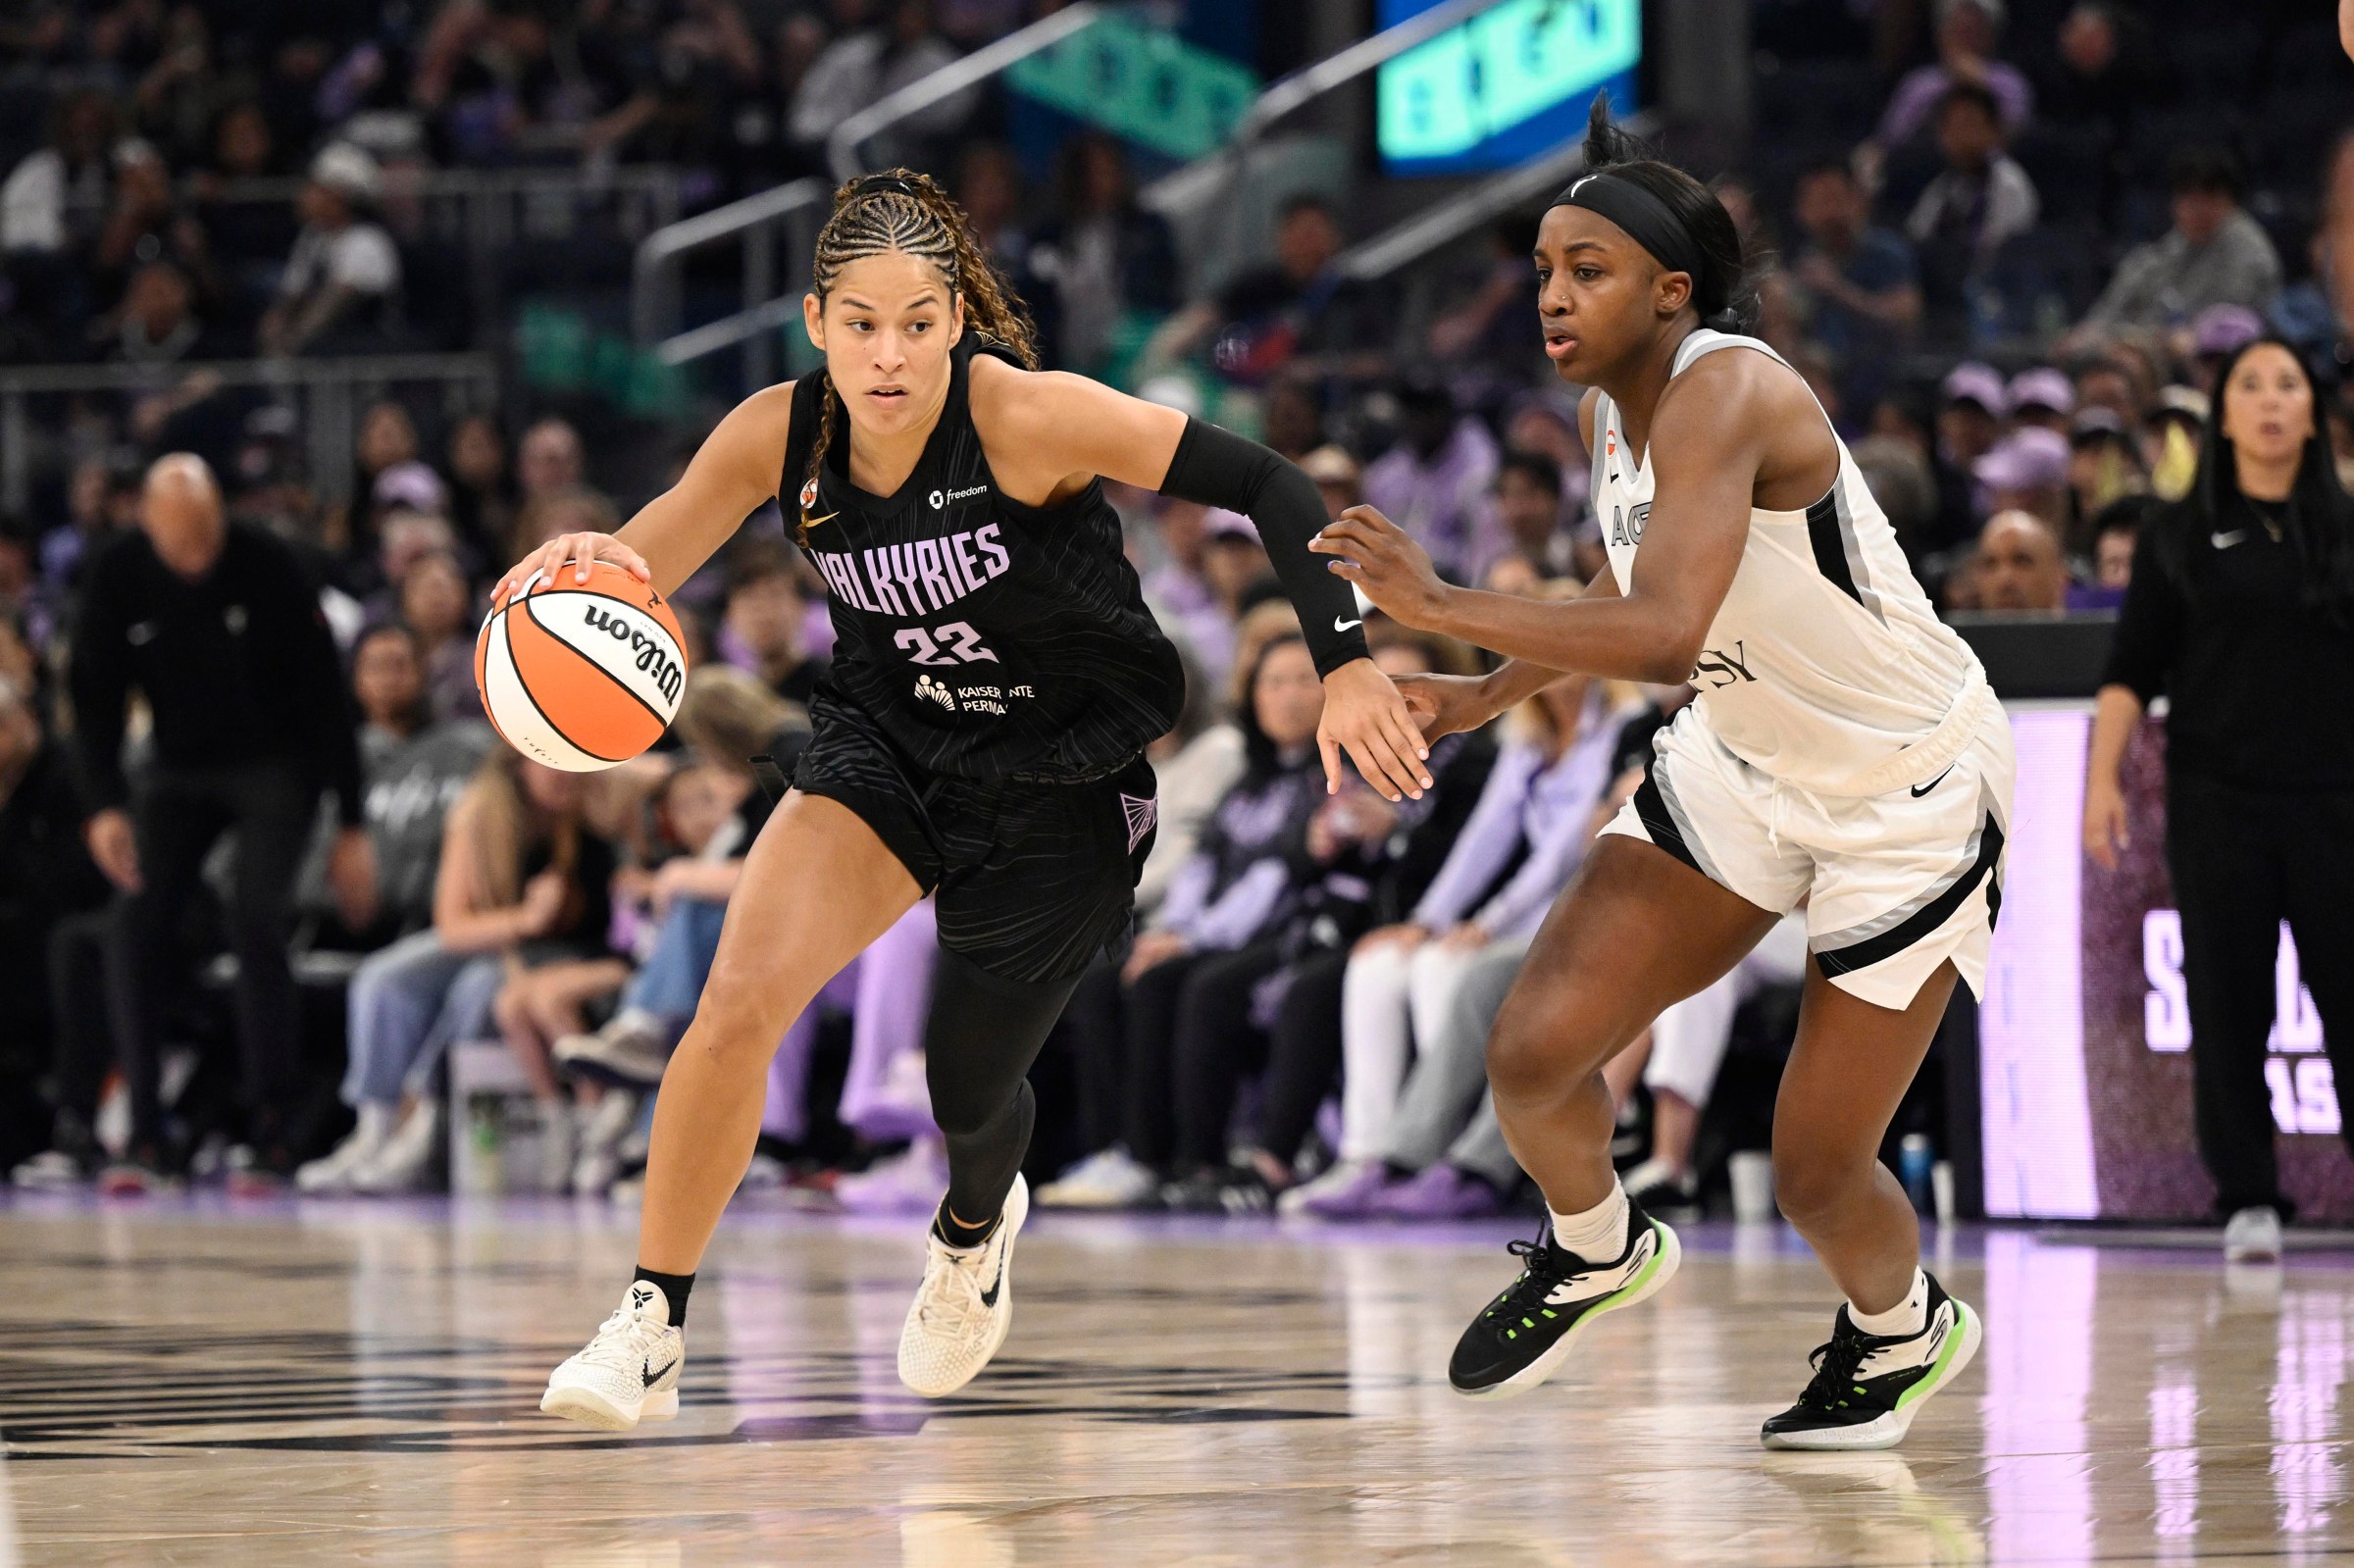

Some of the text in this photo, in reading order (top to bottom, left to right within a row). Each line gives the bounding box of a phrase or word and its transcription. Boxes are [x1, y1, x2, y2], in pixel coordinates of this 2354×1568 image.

[946, 484, 988, 506] freedom
[809, 523, 1010, 617] VALKYRIES
[584, 604, 682, 708] Wilson
[893, 621, 999, 666] 22
[957, 685, 1002, 699] KAISER
[962, 700, 1008, 716] PERMA
